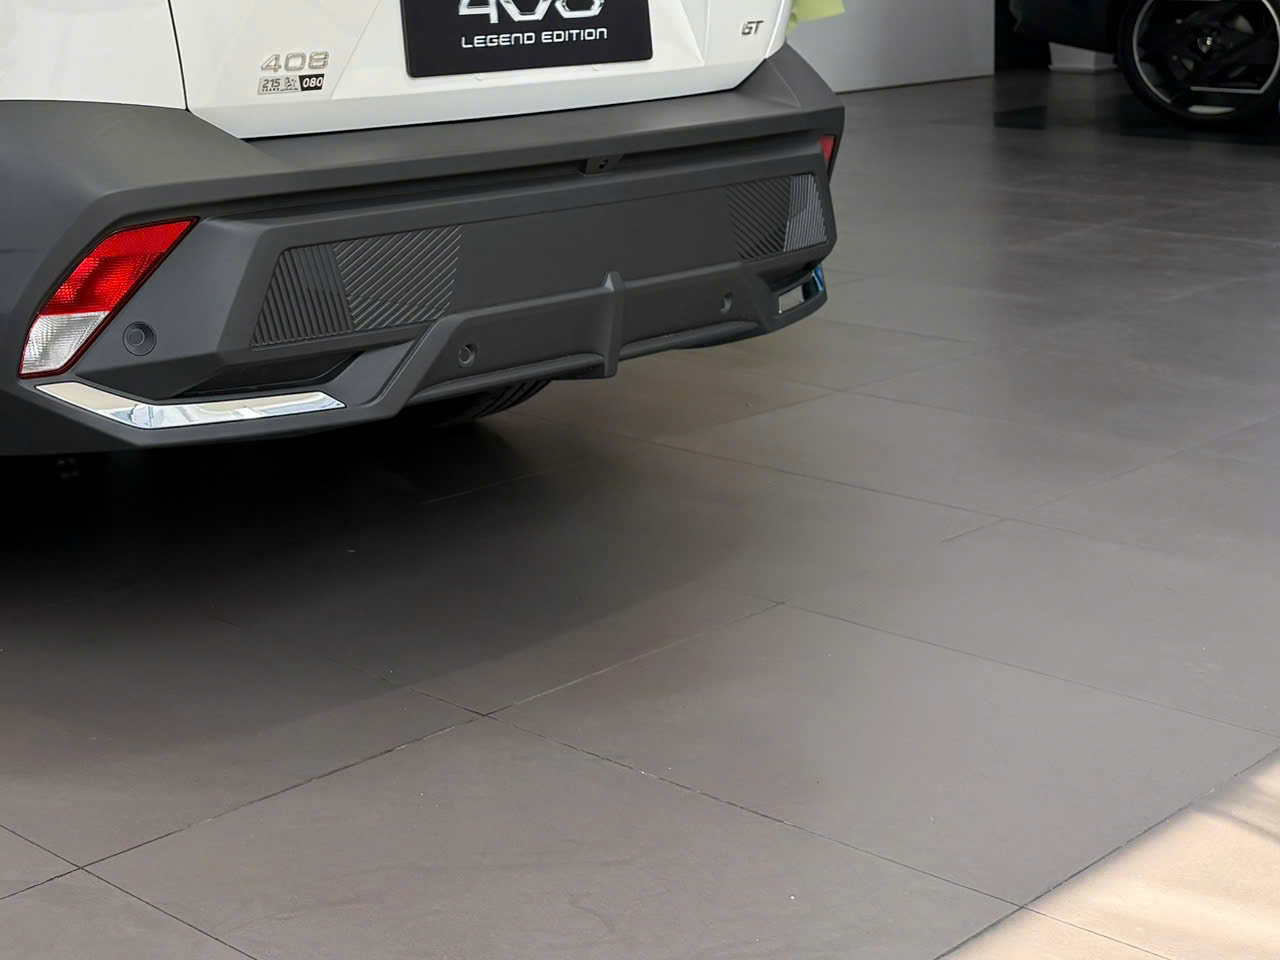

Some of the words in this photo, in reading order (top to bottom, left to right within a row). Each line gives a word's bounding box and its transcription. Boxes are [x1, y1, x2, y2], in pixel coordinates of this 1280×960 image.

[741, 20, 765, 36] GT
[461, 32, 535, 48] LEGEND
[541, 27, 608, 43] EDITION
[261, 51, 330, 73] 408
[262, 78, 281, 89] 215
[302, 76, 323, 88] 080
